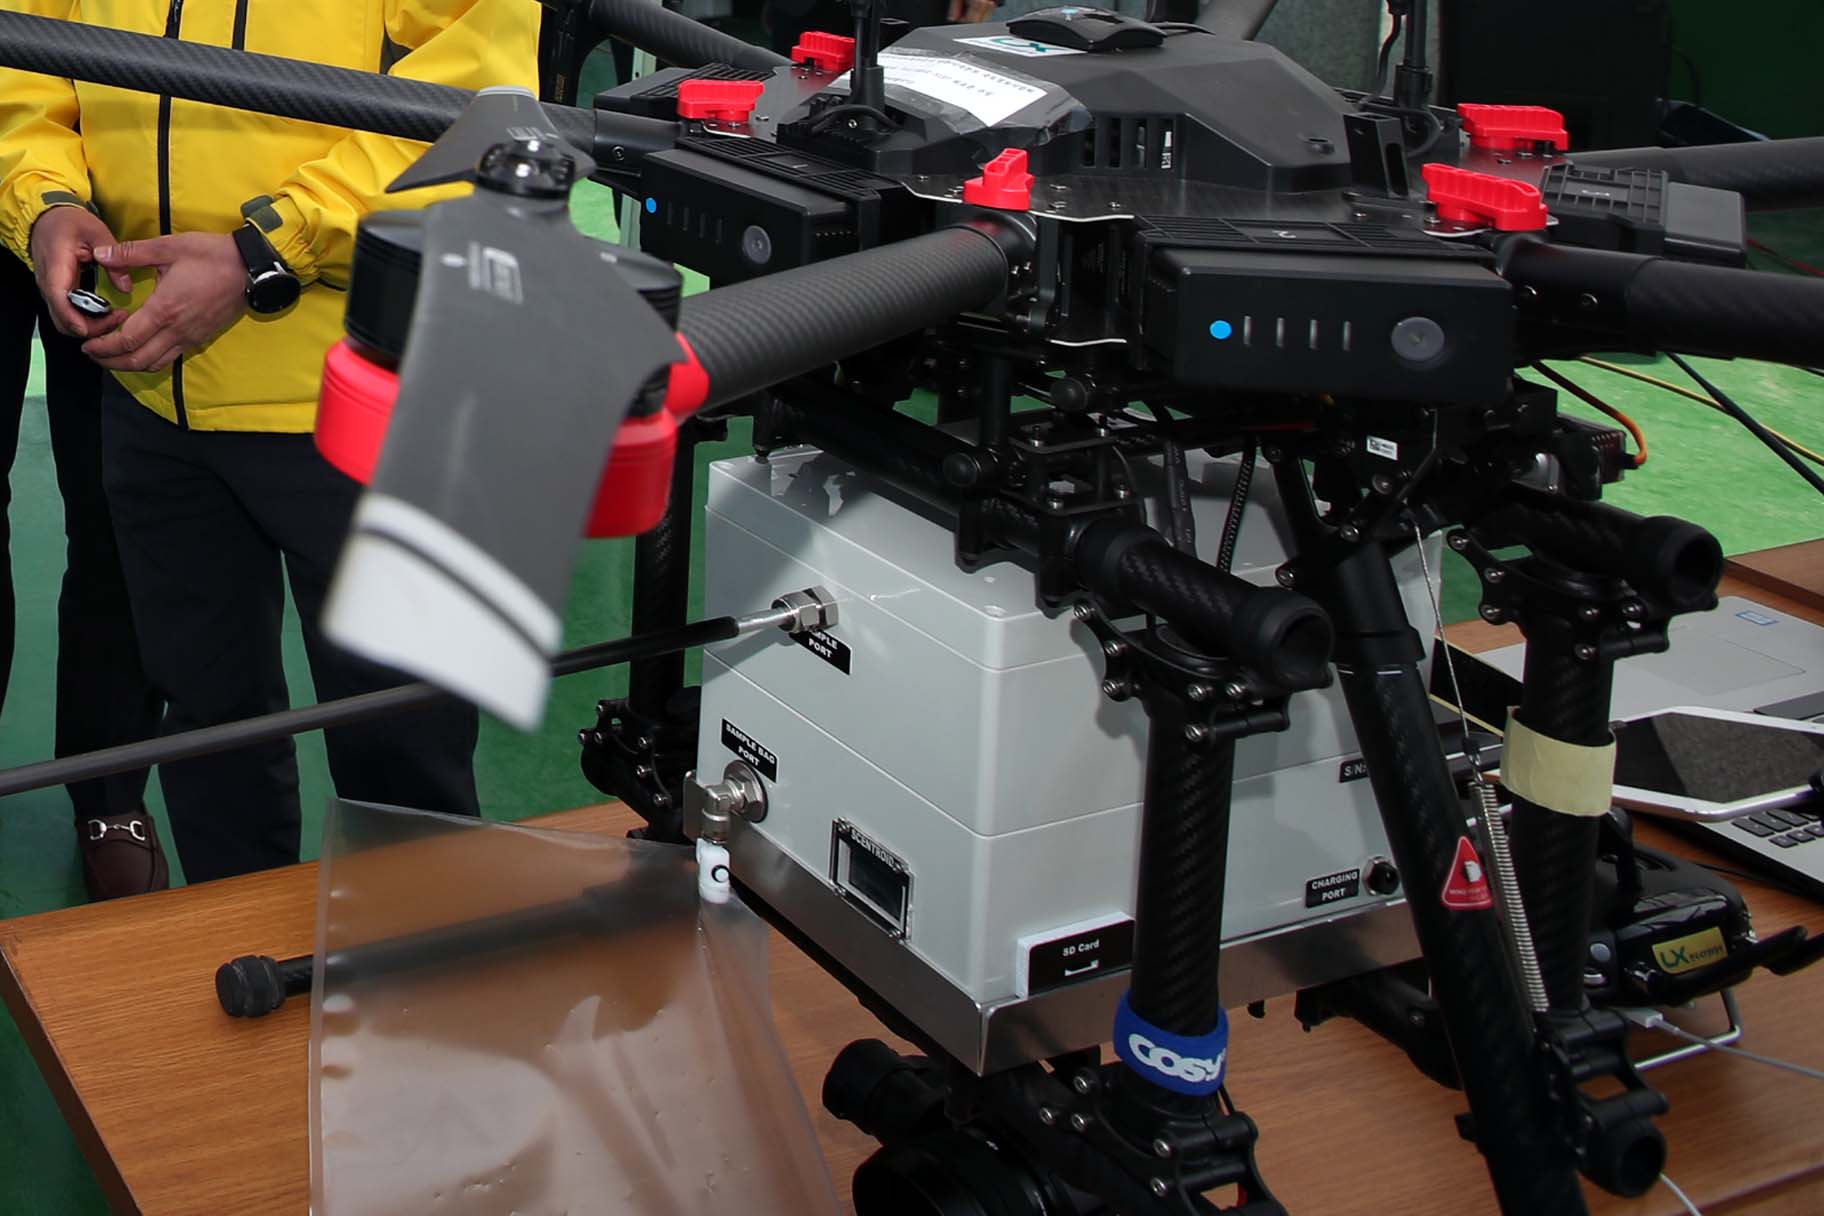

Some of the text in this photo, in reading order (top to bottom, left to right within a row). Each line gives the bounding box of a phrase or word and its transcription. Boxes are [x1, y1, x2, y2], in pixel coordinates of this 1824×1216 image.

[808, 630, 839, 651] MPLE
[808, 637, 833, 658] PORT
[726, 723, 776, 765] SAMPLE BAG
[738, 745, 760, 766] PORT
[1311, 871, 1359, 890] CHARGING
[1321, 887, 1346, 902] PORT
[1062, 938, 1100, 957] SD Card
